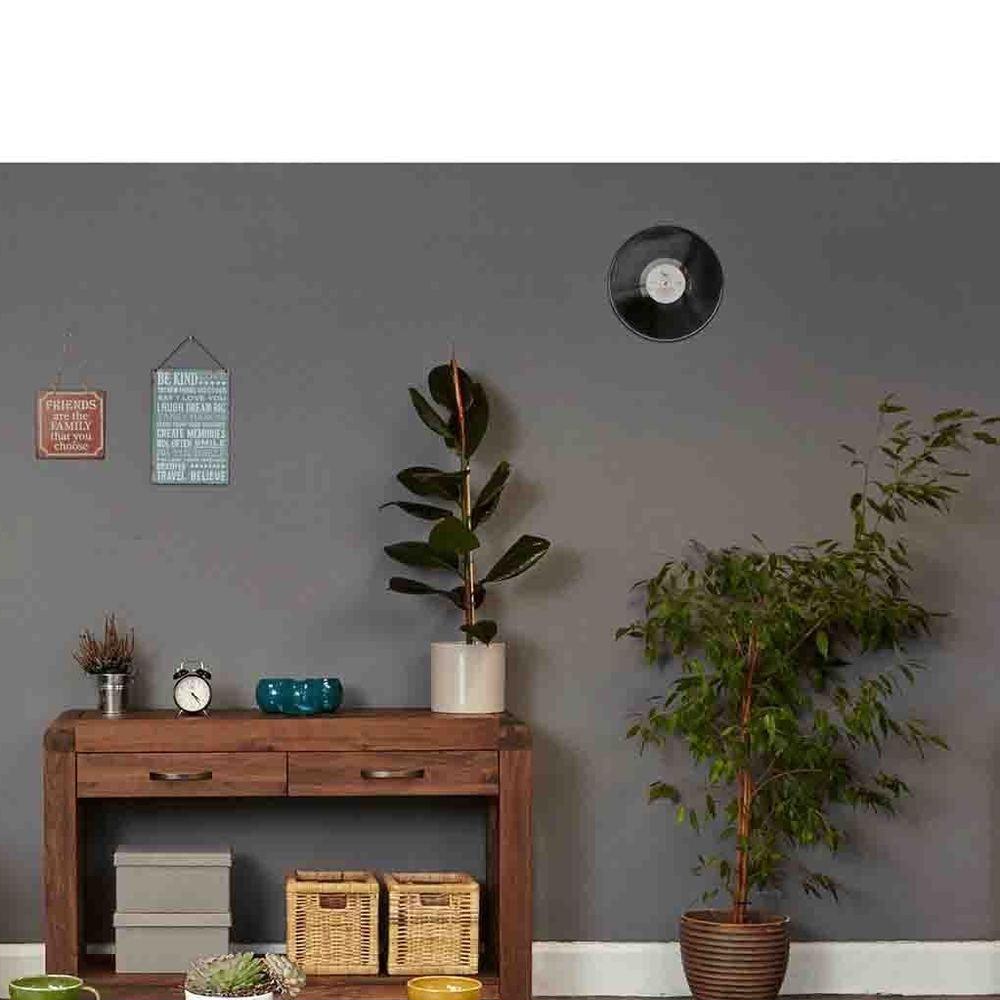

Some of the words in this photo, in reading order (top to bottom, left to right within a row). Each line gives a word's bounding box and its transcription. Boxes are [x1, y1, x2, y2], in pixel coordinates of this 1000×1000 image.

[157, 371, 171, 385] BE
[173, 371, 198, 385] KIND
[47, 399, 97, 410] FRIENDS
[52, 413, 70, 421] are
[72, 410, 88, 421] the
[51, 421, 91, 431] FAMILY
[73, 432, 92, 442] you
[157, 428, 184, 439] CREATE
[187, 428, 226, 439] MEMORIES
[190, 470, 226, 481] BELIEVE
